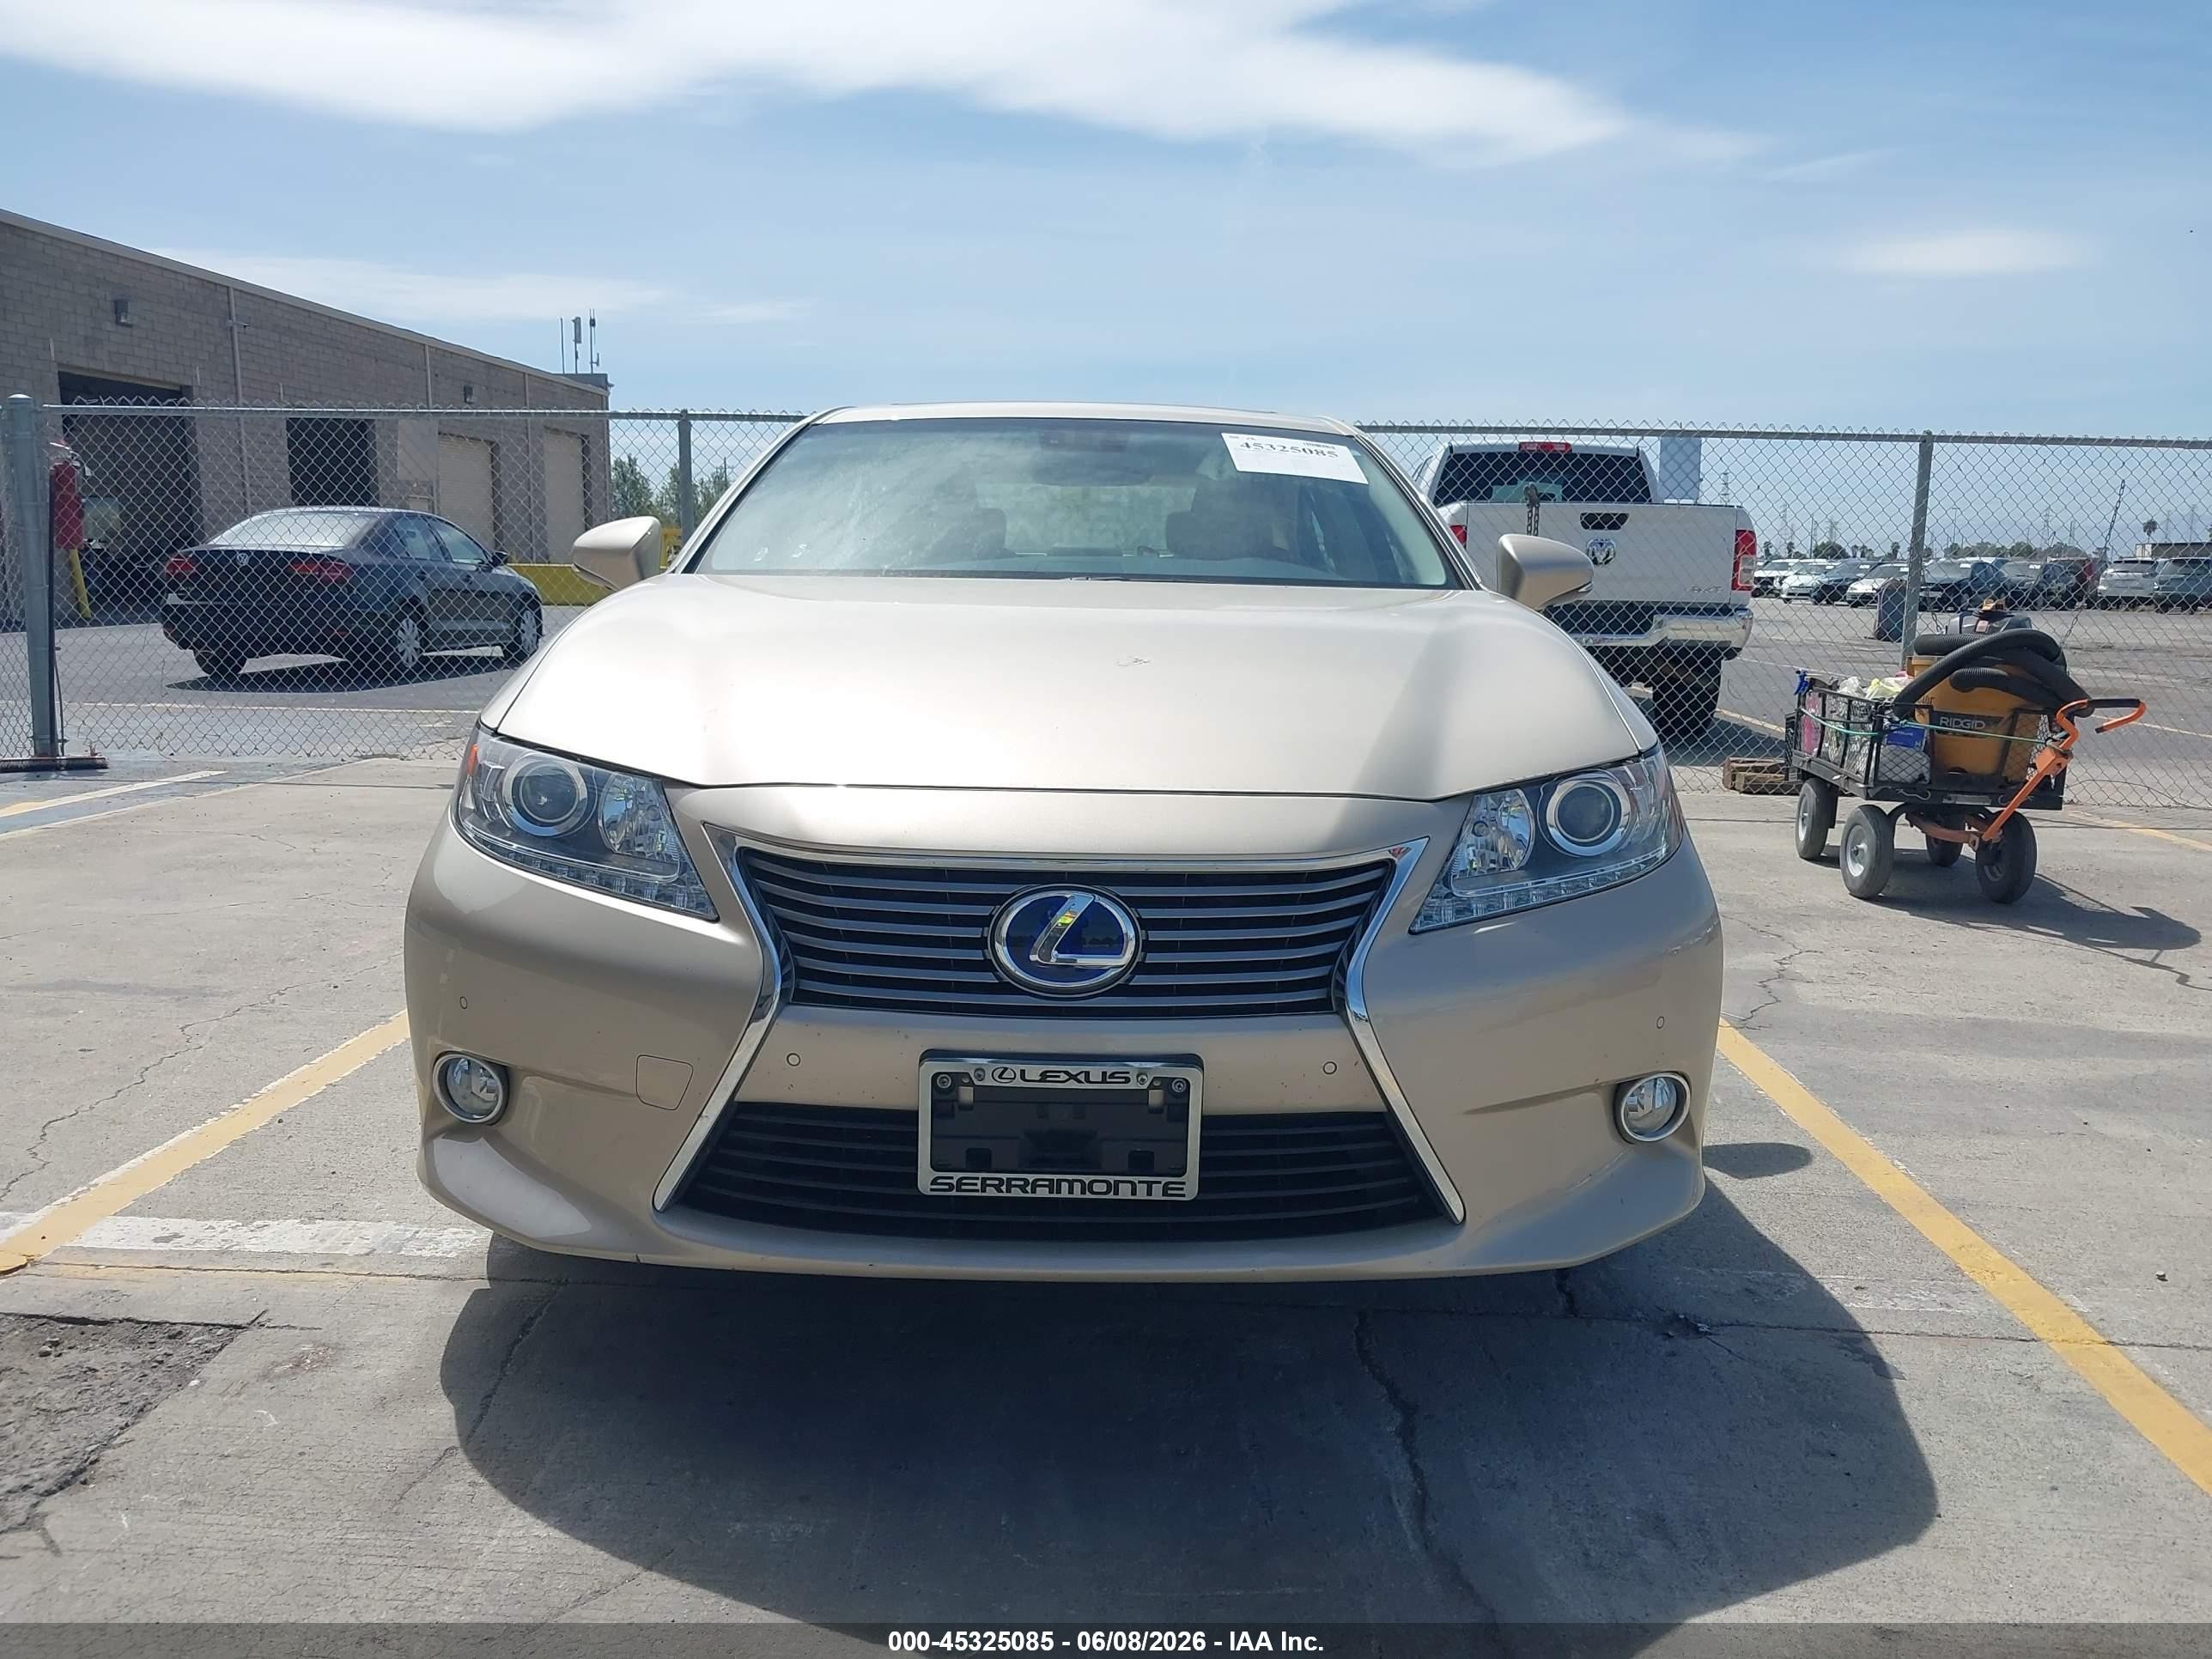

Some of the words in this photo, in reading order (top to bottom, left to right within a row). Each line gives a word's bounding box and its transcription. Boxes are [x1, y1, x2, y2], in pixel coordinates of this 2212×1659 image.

[1240, 441, 1339, 459] 45325085
[1939, 716, 1986, 731] RIDGID
[1020, 1068, 1131, 1085] LEXUS
[929, 1176, 1186, 1198] SERRAMONTE
